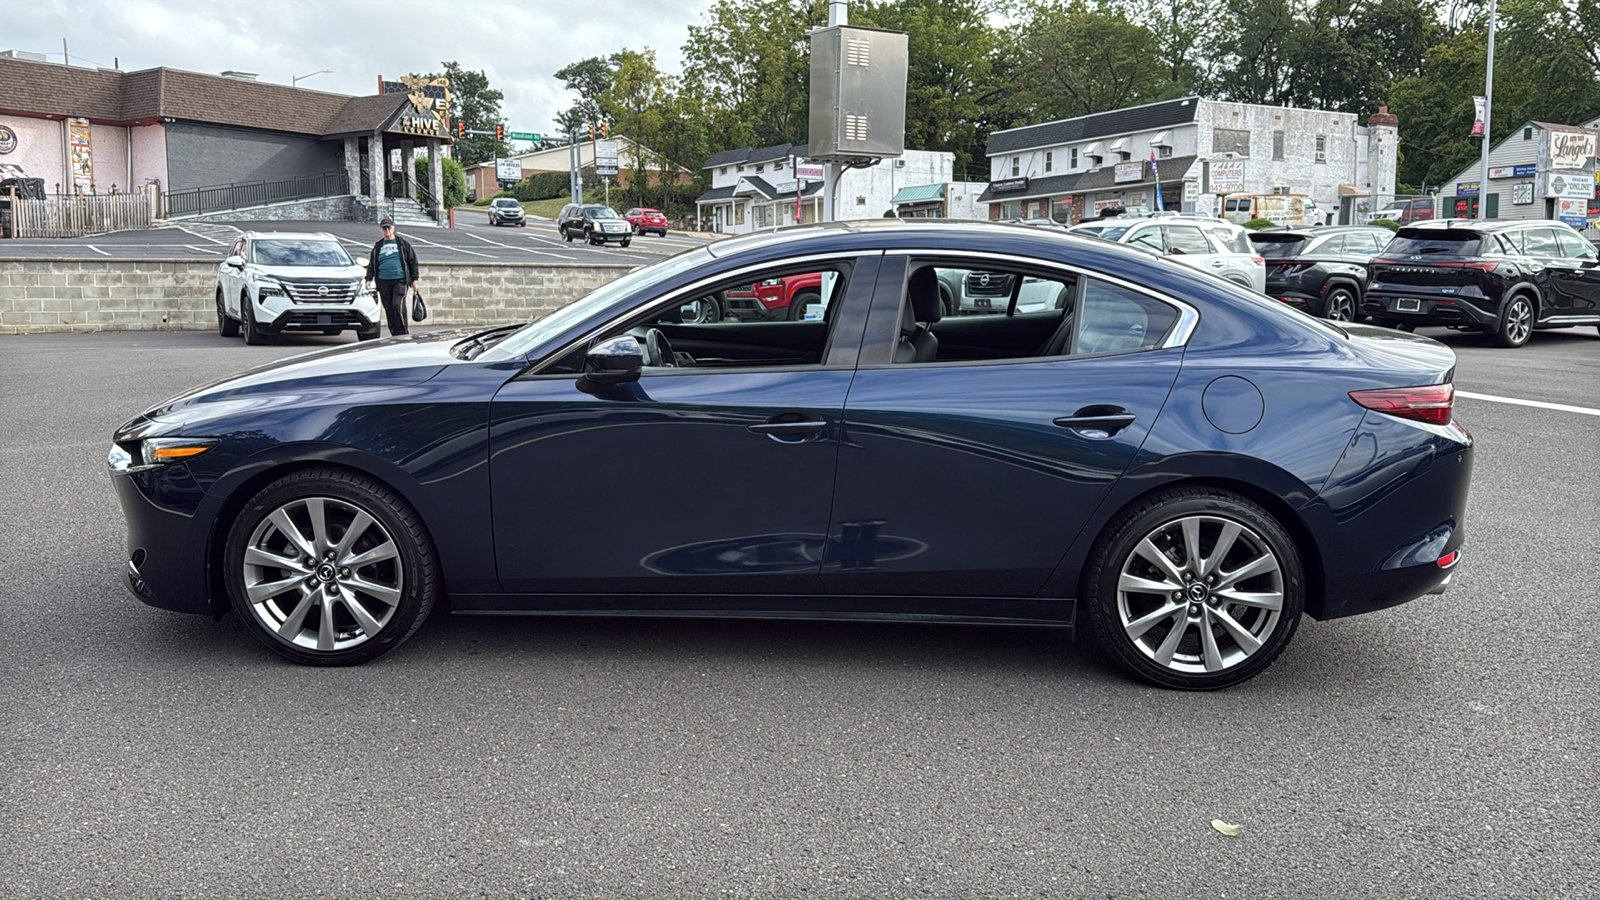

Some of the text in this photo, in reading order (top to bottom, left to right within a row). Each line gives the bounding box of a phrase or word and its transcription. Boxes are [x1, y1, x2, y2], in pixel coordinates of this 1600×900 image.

[411, 116, 440, 131] HIVE
[403, 126, 440, 136] LOUNGE
[511, 132, 533, 140] Woodland
[1553, 134, 1594, 161] Langel's
[1210, 169, 1242, 178] COMPUTERS
